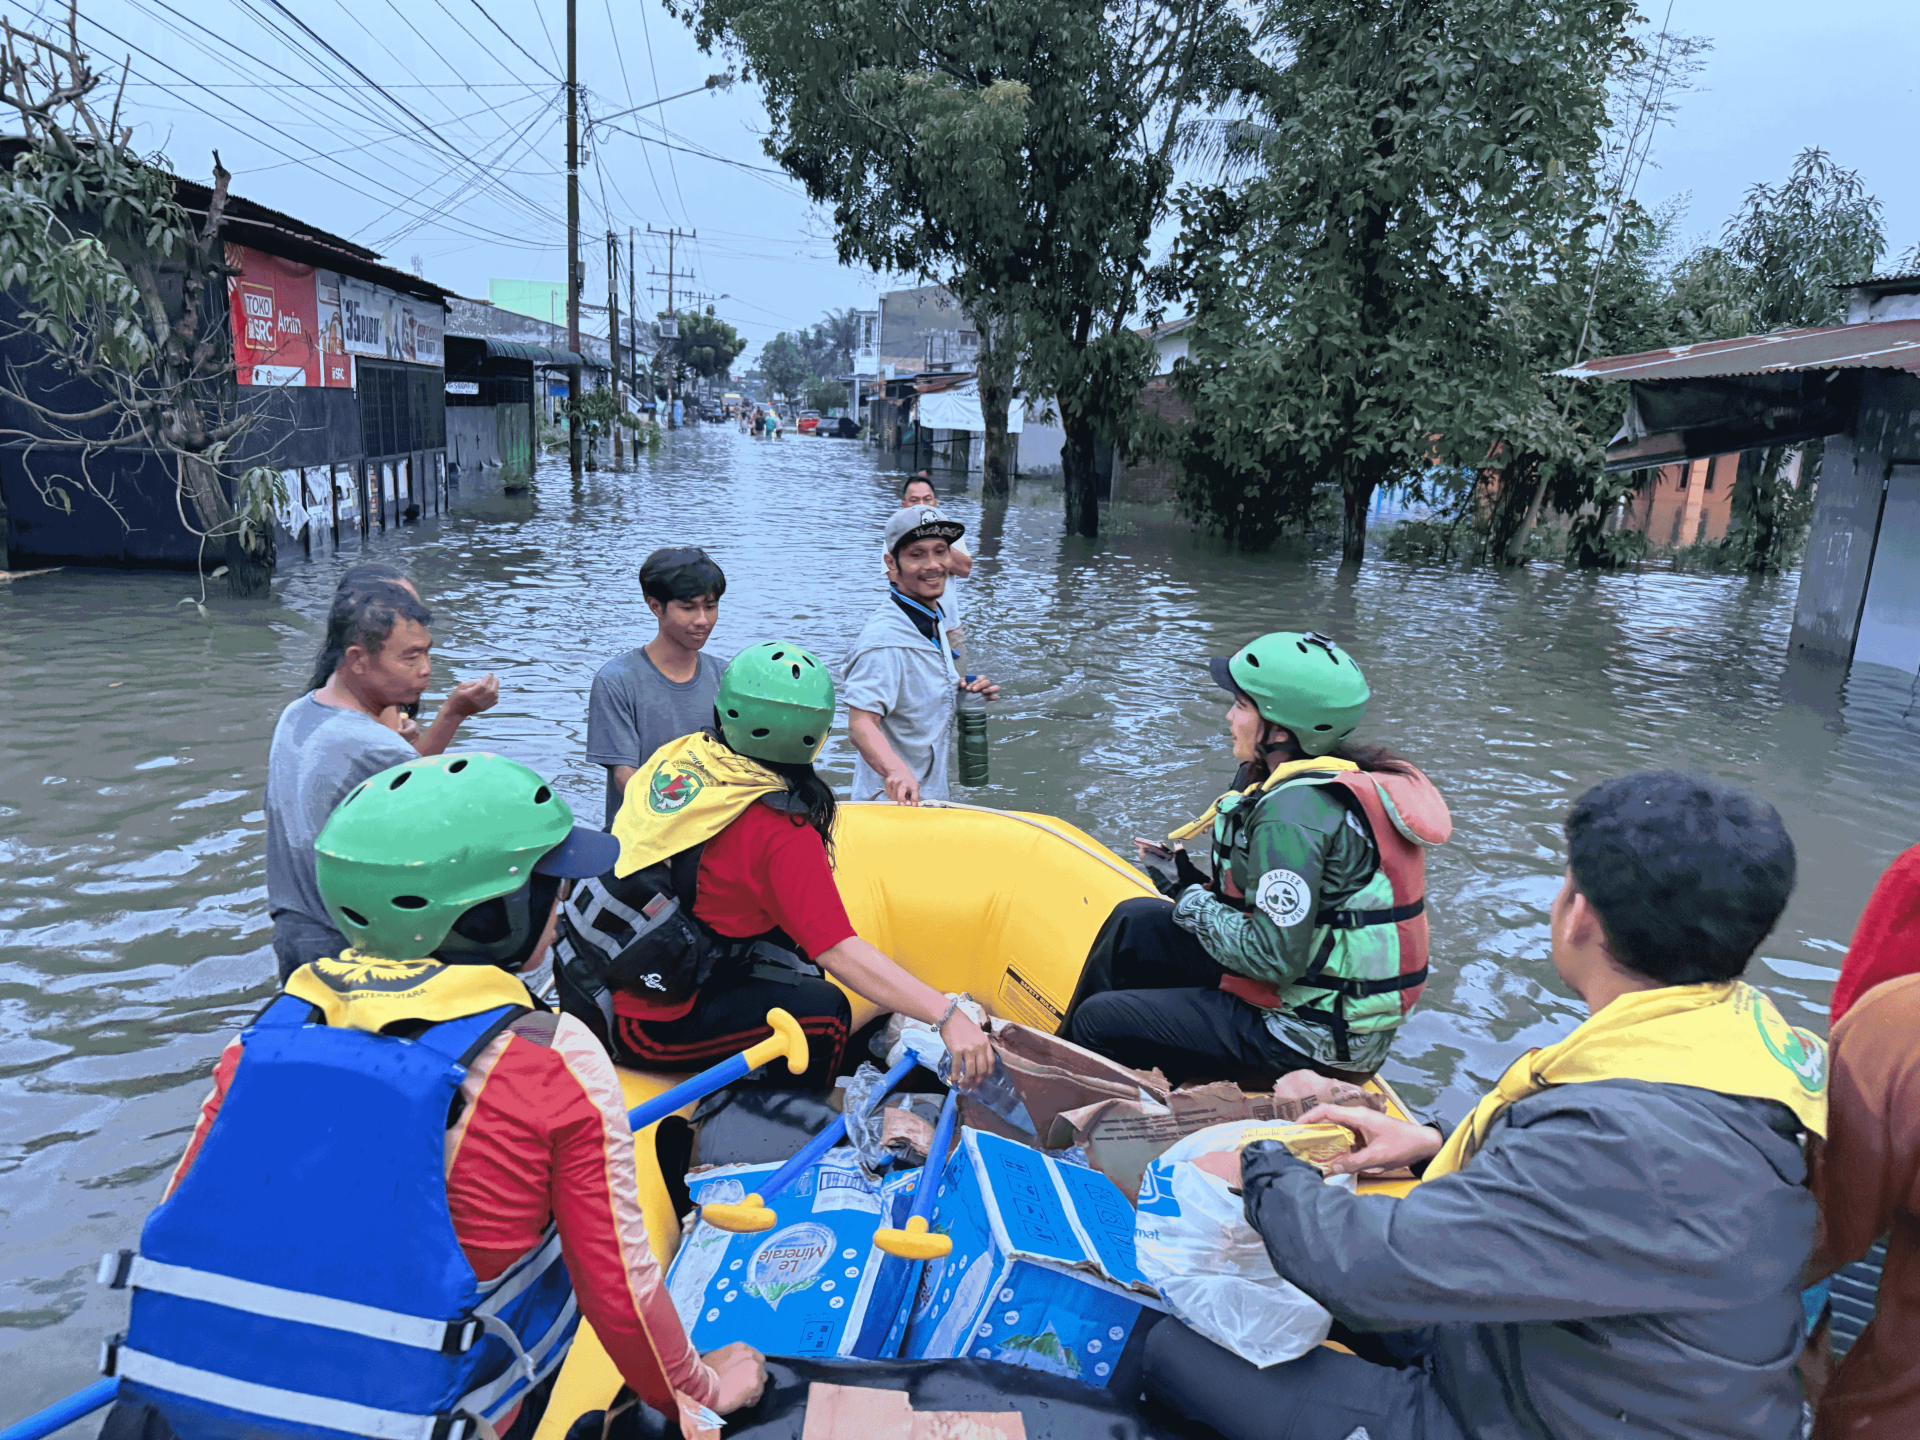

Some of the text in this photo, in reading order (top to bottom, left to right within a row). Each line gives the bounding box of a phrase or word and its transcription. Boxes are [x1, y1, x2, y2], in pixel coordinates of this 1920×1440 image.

[246, 295, 271, 316] TOKO
[253, 318, 273, 342] SRC
[277, 309, 302, 335] Amin
[345, 299, 361, 342] 35
[1267, 871, 1302, 887] RAFTER
[393, 987, 427, 999] UTARA
[1020, 979, 1041, 1000] SAFETY
[1039, 996, 1058, 1015] RULES
[758, 1244, 828, 1264] Minerale
[778, 1259, 799, 1273] Le
